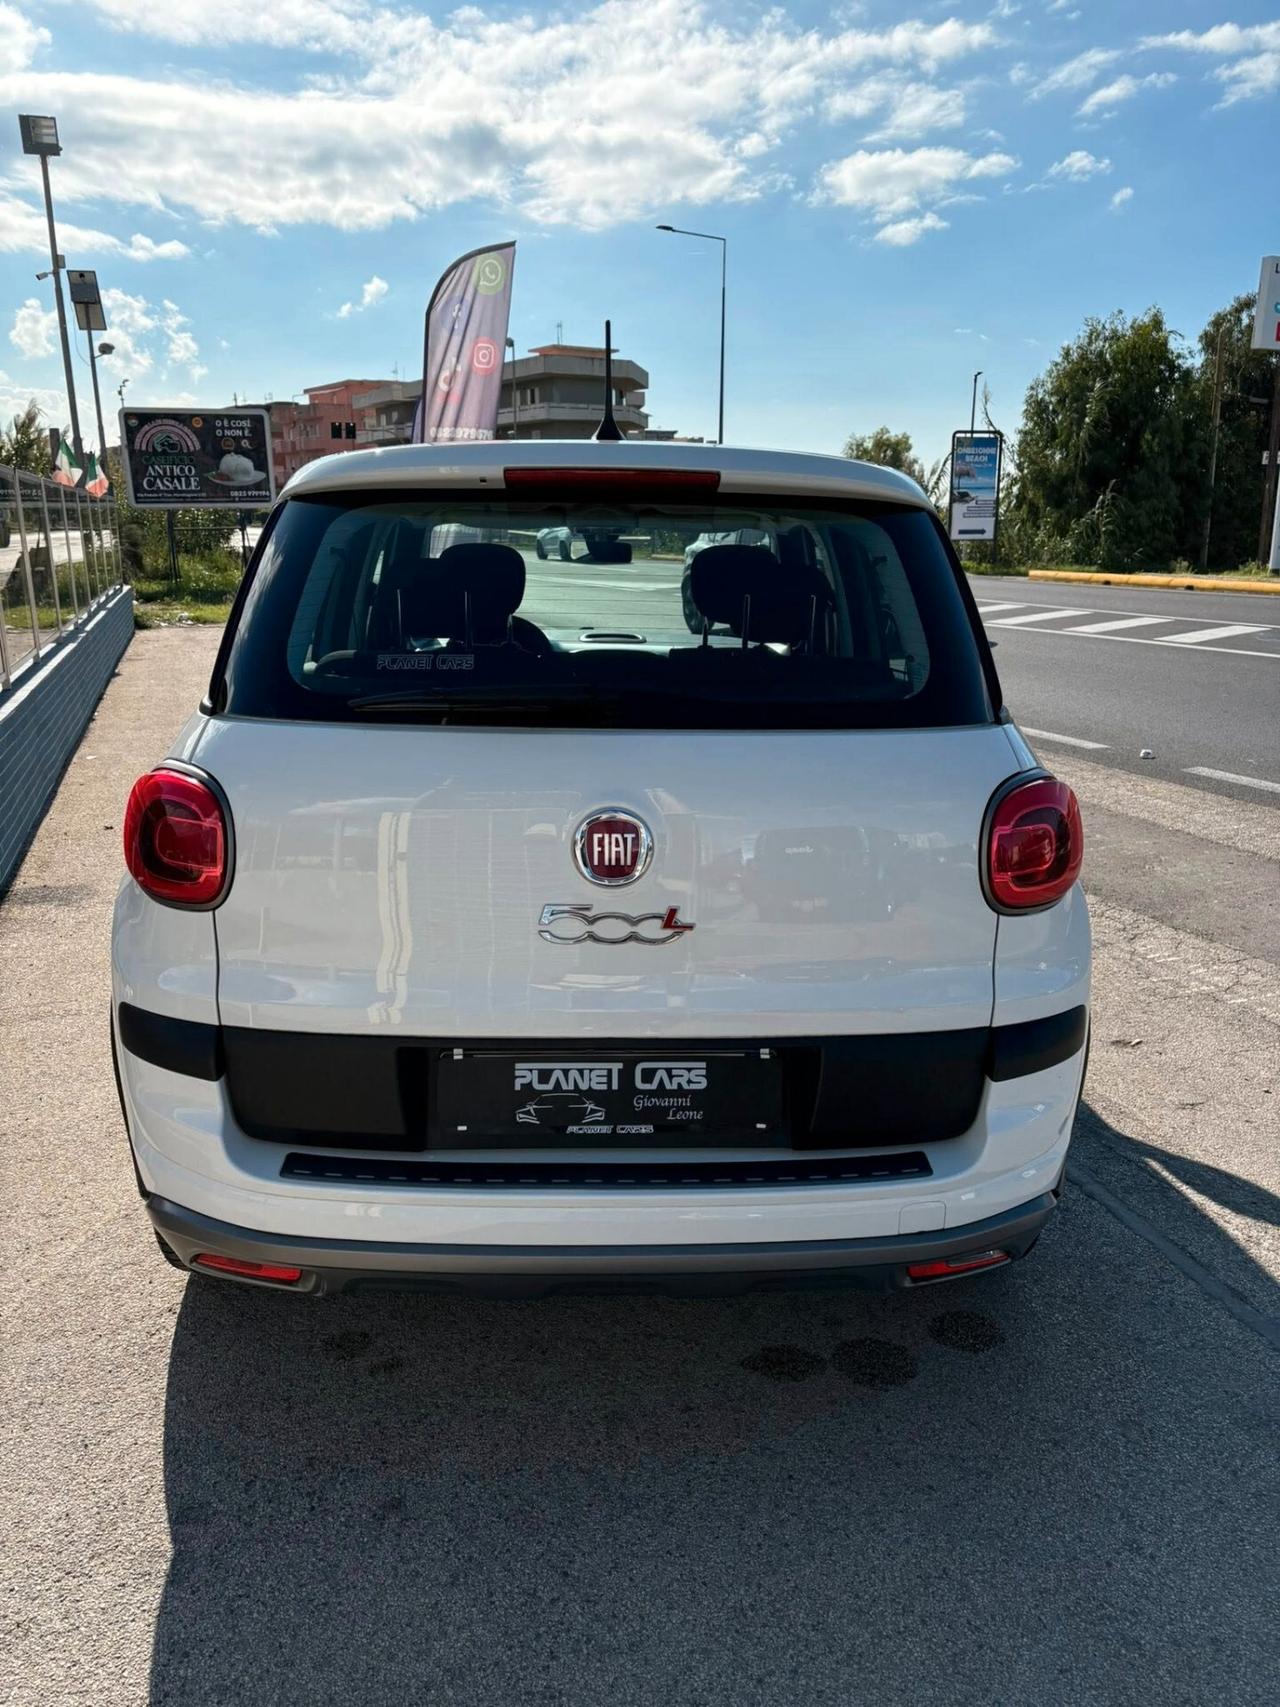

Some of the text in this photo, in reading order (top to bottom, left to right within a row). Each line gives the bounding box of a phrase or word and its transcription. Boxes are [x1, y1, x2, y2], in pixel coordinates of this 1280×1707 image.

[224, 429, 242, 437] NON
[146, 465, 195, 476] ANTICO
[143, 477, 200, 490] CASALE
[377, 654, 474, 670] PLANET CARS
[592, 833, 636, 866] FIAT
[514, 1062, 708, 1091] PLANET CARS
[633, 1094, 692, 1111] Giovanni
[666, 1107, 704, 1120] Leone
[566, 1124, 654, 1134] PLANET CARS
